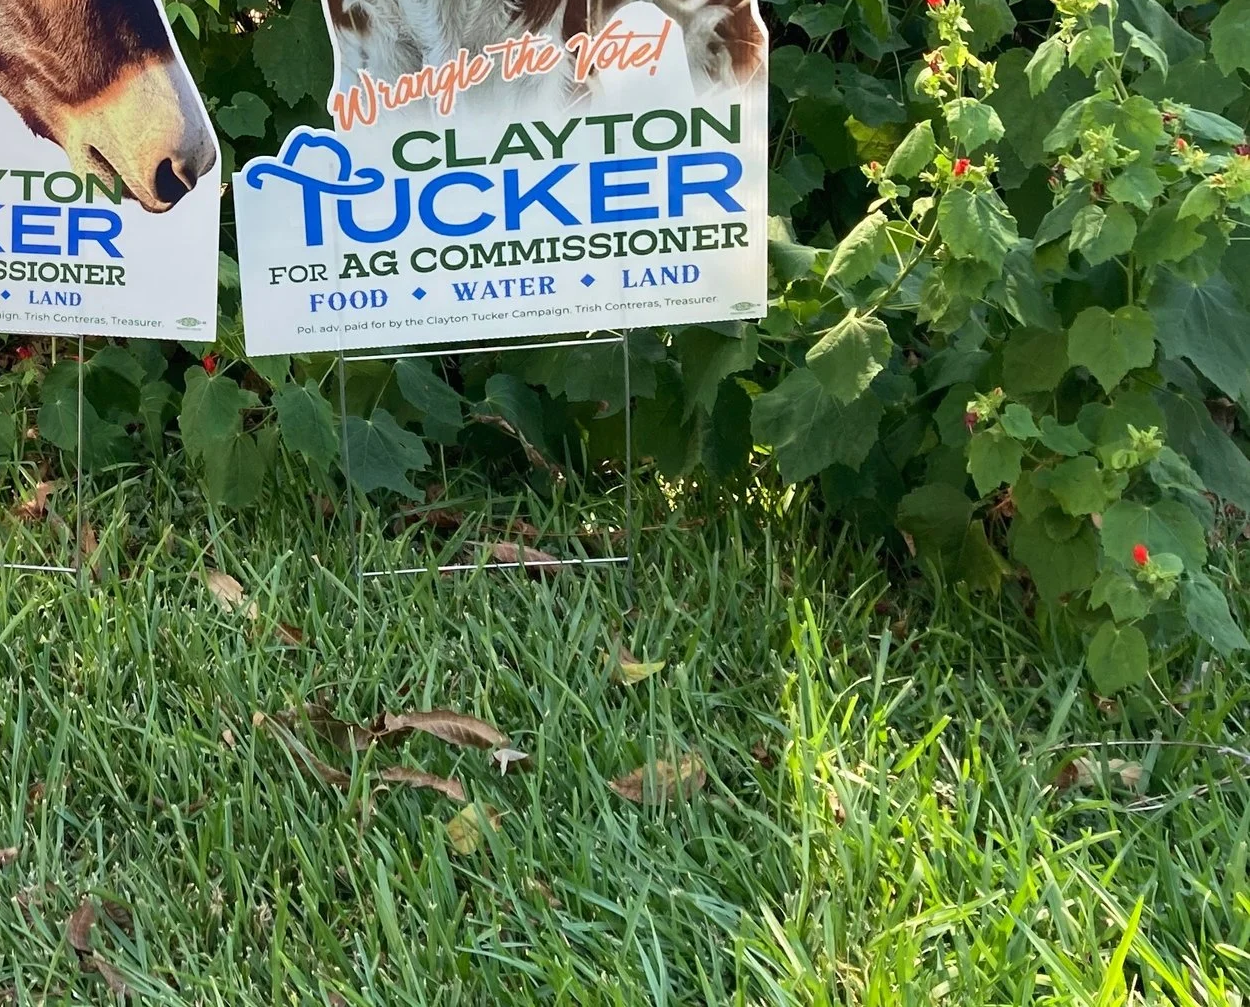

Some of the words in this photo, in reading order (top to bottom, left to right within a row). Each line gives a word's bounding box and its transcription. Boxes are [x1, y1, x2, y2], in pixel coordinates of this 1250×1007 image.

[334, 51, 490, 130] Wrangle
[487, 33, 560, 79] the
[568, 19, 672, 82] Vote!
[392, 104, 741, 172] CLAYTON
[246, 147, 746, 246] TUCKER
[269, 263, 327, 284] FOR
[338, 251, 400, 279] AG
[410, 222, 749, 274] COMMISSIONER
[28, 290, 82, 307] LAND
[310, 289, 389, 313] FOOD
[451, 276, 557, 301] WATER
[621, 264, 700, 288] LAND
[344, 322, 368, 332] paid
[371, 320, 386, 329] for
[389, 319, 402, 329] by
[405, 317, 424, 326] the
[426, 314, 469, 326] Clayton
[471, 311, 509, 322] Tucker
[512, 307, 572, 319] Campaign.
[575, 304, 601, 314] Trish
[605, 300, 661, 311] Contreras,
[665, 296, 718, 307] Treasurer.
[24, 312, 50, 321] Trish
[53, 313, 108, 325] Contreras,
[112, 316, 164, 328] Treasurer.
